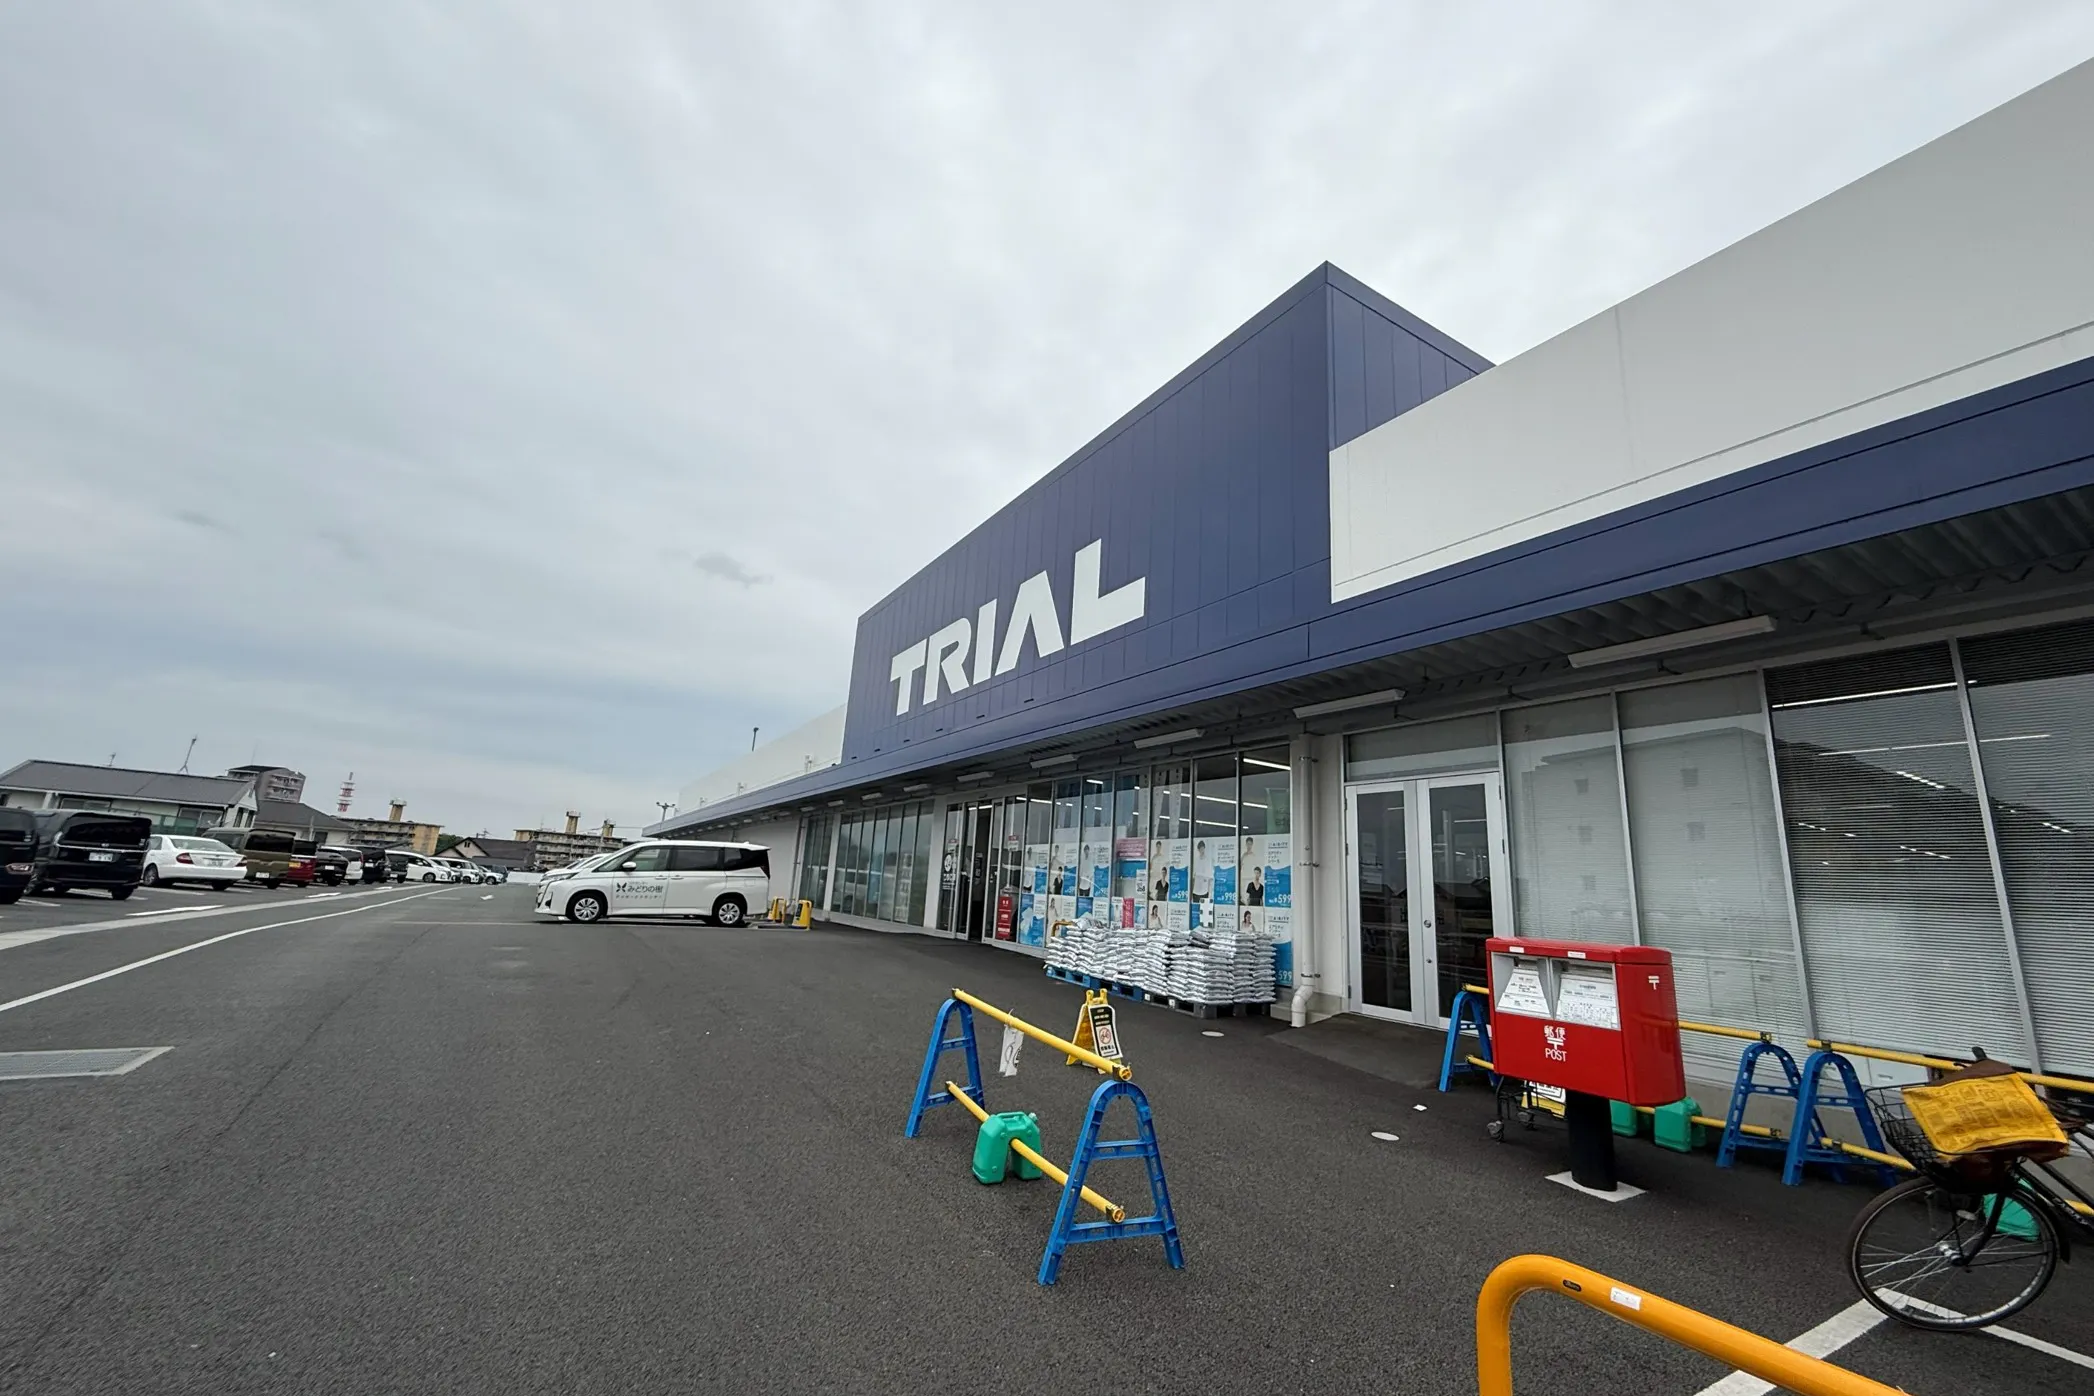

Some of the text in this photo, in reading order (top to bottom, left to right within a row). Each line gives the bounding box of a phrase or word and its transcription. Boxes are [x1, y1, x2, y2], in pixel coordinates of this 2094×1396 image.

[890, 538, 1146, 716] TRIAL
[1544, 1025, 1566, 1040] 郵便
[1545, 1048, 1567, 1062] POST
